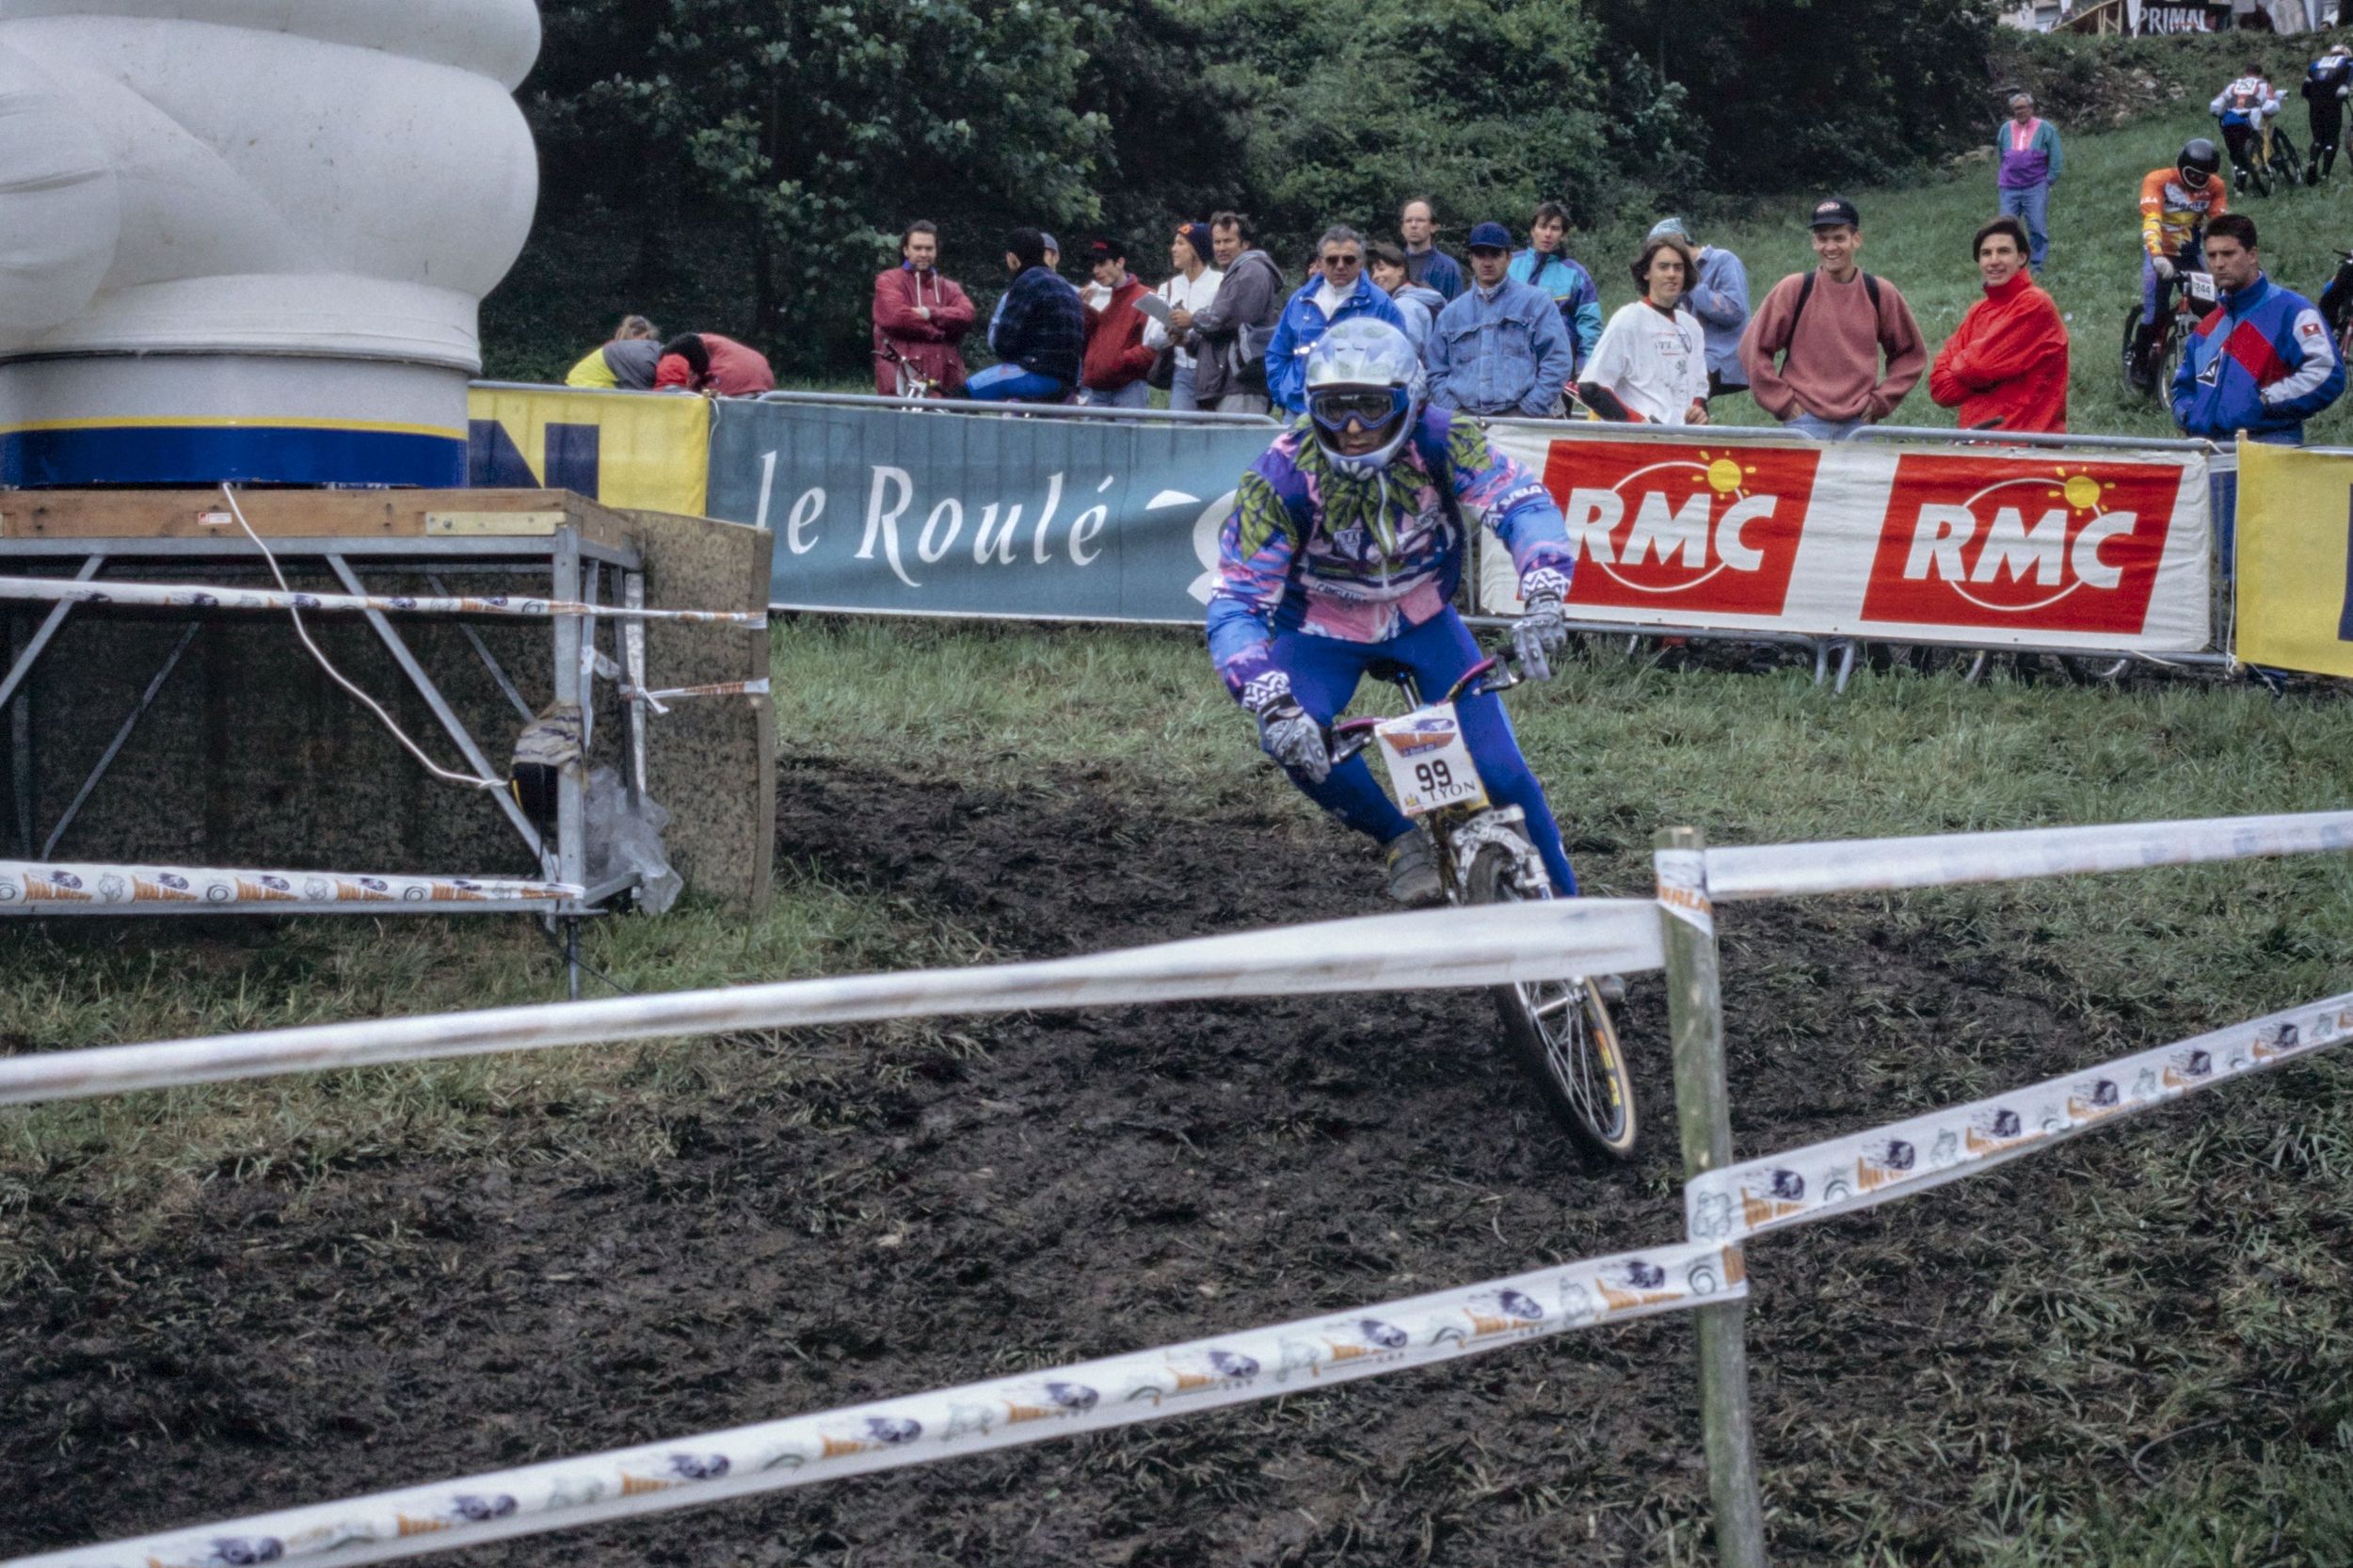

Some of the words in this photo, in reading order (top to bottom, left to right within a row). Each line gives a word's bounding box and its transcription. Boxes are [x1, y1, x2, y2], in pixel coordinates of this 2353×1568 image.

[2138, 7, 2213, 36] PRIMAL
[757, 450, 827, 555] le
[854, 465, 1114, 588] Roulé
[1564, 487, 1779, 572] RMC
[1903, 502, 2138, 589] RMC
[1415, 759, 1452, 792] 99
[1430, 779, 1477, 801] LYON
